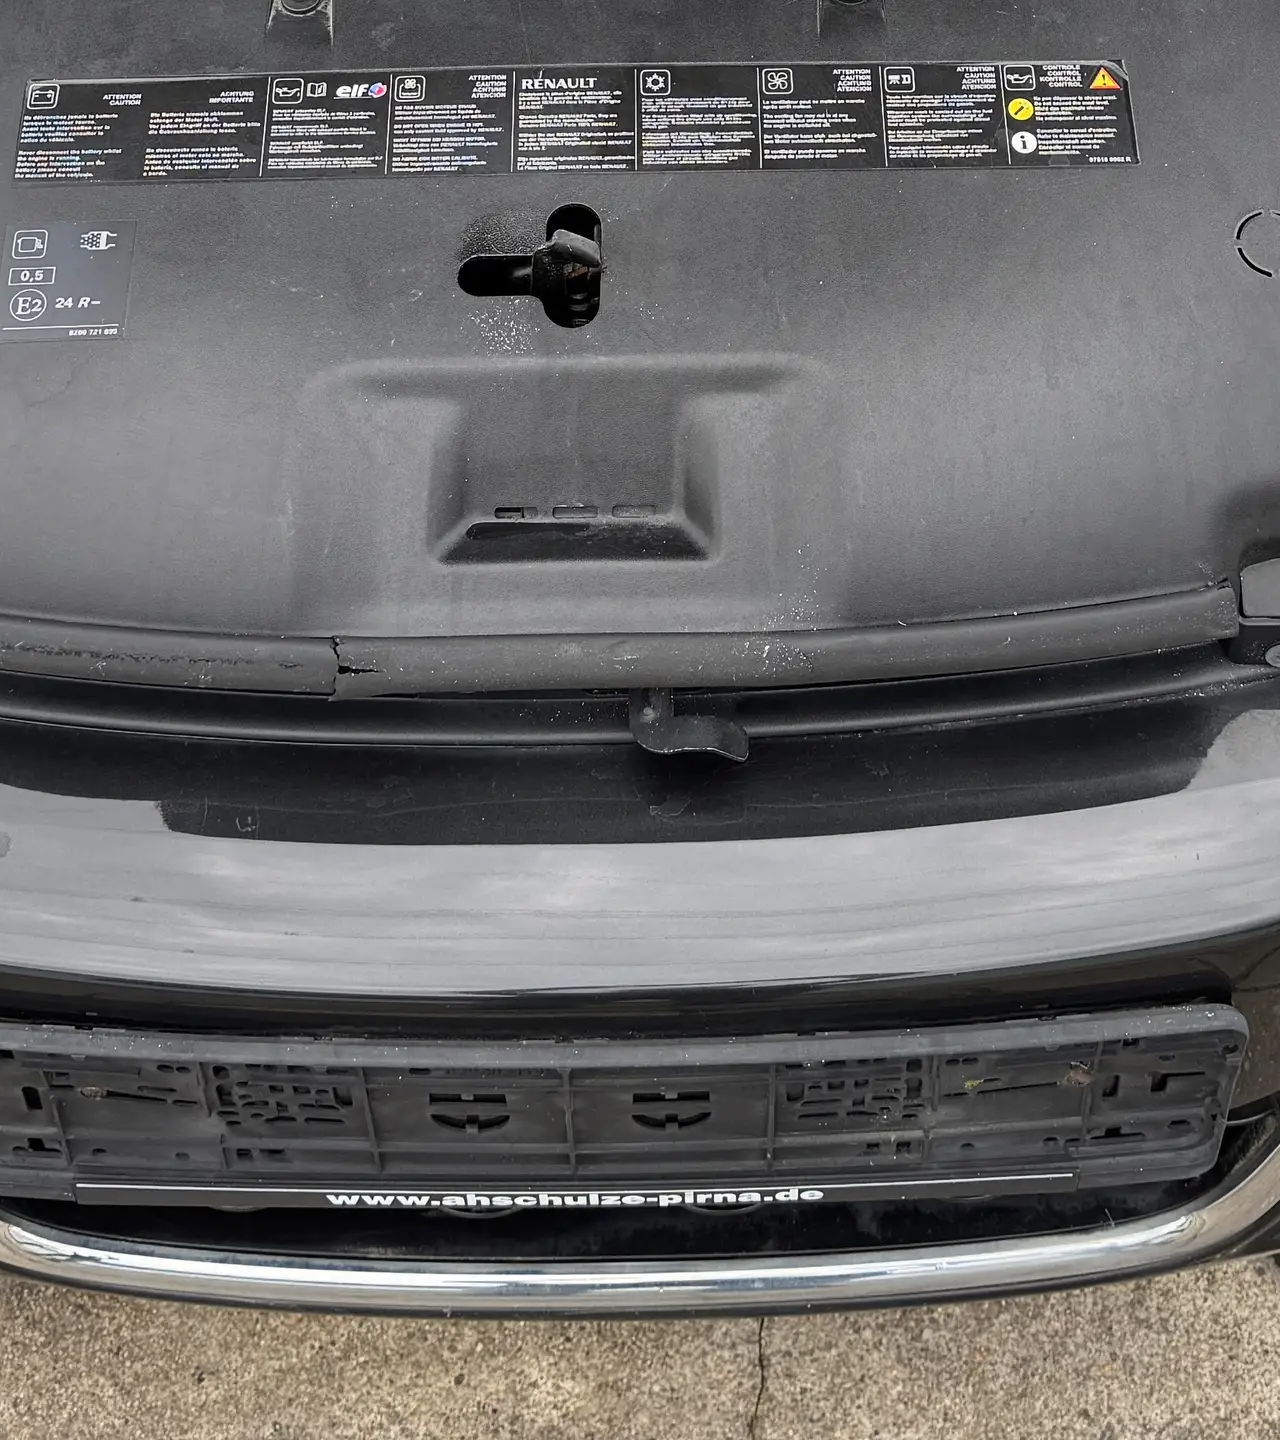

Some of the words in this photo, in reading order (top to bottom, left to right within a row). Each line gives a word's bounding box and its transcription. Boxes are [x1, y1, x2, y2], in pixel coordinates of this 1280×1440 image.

[522, 78, 597, 89] RENAULT
[336, 84, 369, 97] elf
[20, 270, 43, 282] 0,5
[16, 297, 42, 314] E2
[55, 297, 73, 308] 24
[326, 1188, 824, 1207] www.ahschulze-pirna.de
